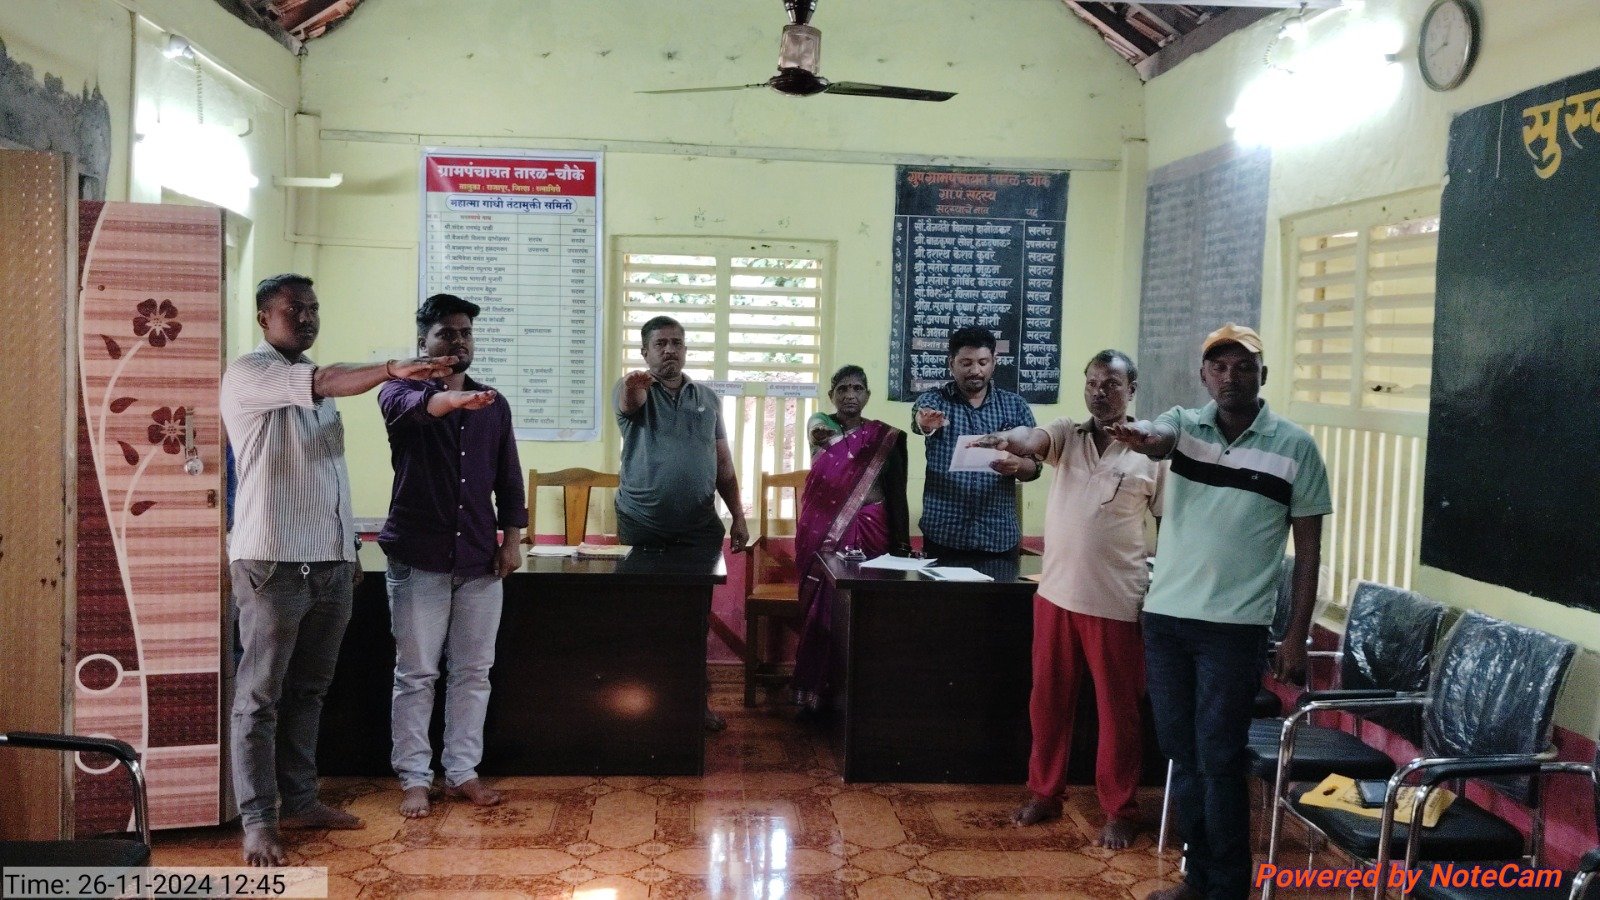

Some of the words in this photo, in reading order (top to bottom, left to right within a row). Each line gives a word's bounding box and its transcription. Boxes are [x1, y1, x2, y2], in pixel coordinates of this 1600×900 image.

[437, 161, 511, 179] ग्रामपंचायत
[513, 164, 586, 181] तारळ-चौके
[451, 199, 479, 208] महात्मा
[483, 197, 504, 209] गांधी
[506, 198, 541, 212] तंटामुक्ती
[544, 197, 573, 210] समिती
[1027, 223, 1054, 236] सरपंच
[1028, 251, 1057, 263] सदस्य
[1028, 265, 1056, 277] सदस्य
[1028, 279, 1054, 289] सदस्य
[1026, 291, 1053, 302] सदस्य
[1027, 304, 1053, 316] सदस्य
[1025, 317, 1054, 328] सदस्य
[1026, 330, 1052, 342] सदस्य
